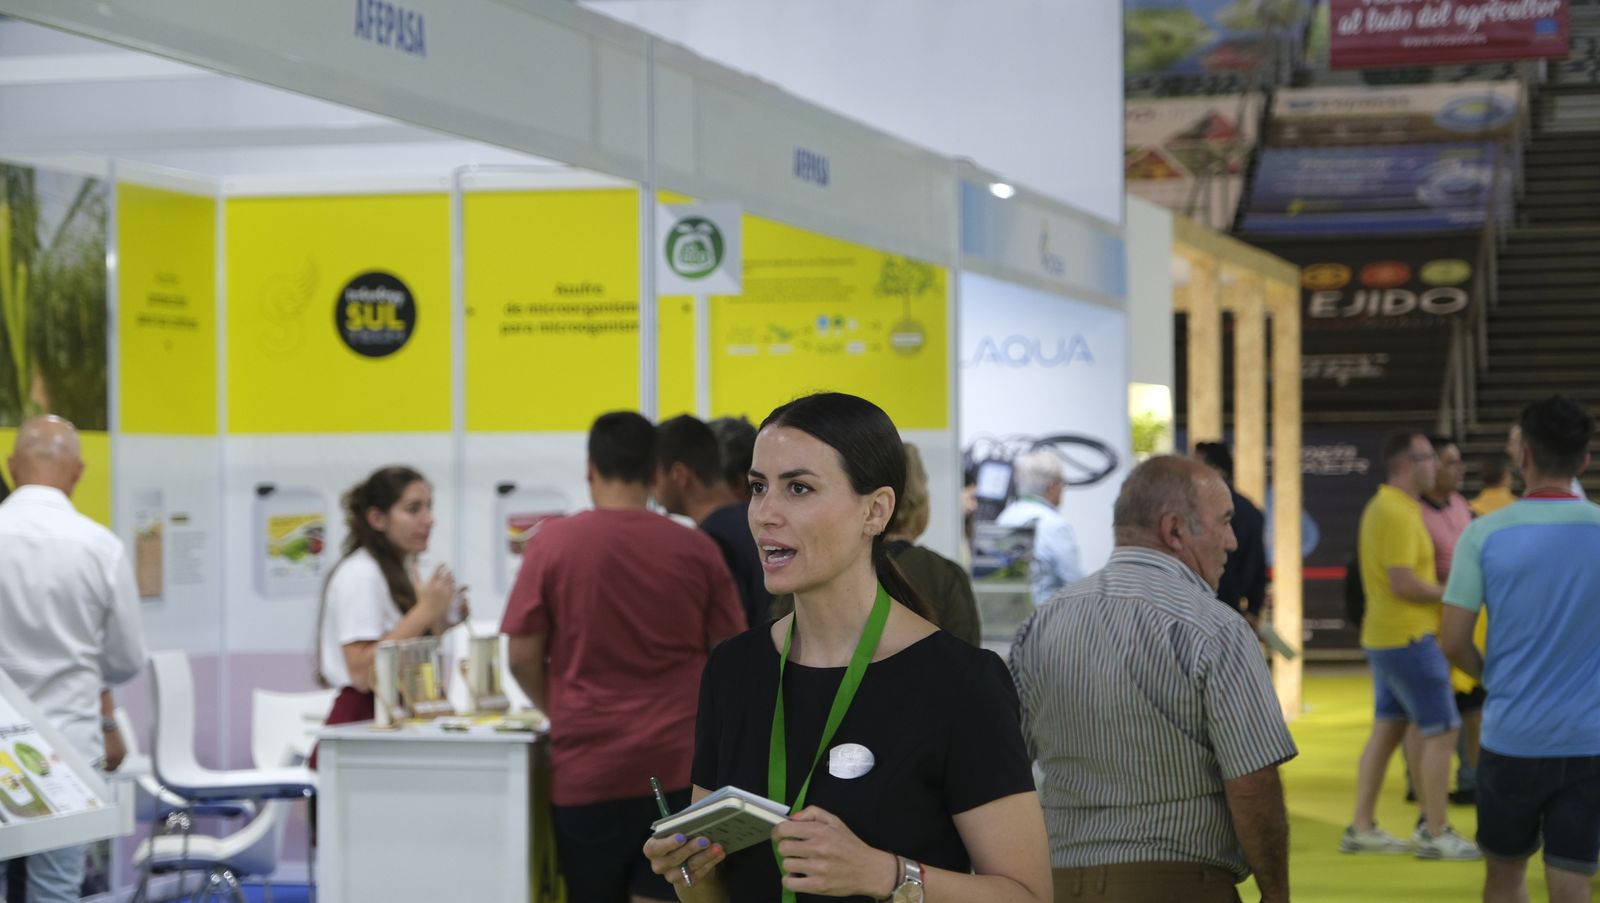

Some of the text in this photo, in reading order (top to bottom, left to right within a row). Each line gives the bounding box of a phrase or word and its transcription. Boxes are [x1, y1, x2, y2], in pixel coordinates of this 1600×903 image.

[354, 0, 427, 58] AFEPASA
[1338, 8, 1364, 35] al
[1416, 3, 1450, 28] del
[1454, 0, 1562, 33] agricultor
[345, 302, 406, 331] SUL
[527, 300, 639, 320] microorganism
[1308, 287, 1469, 318] EJIDO
